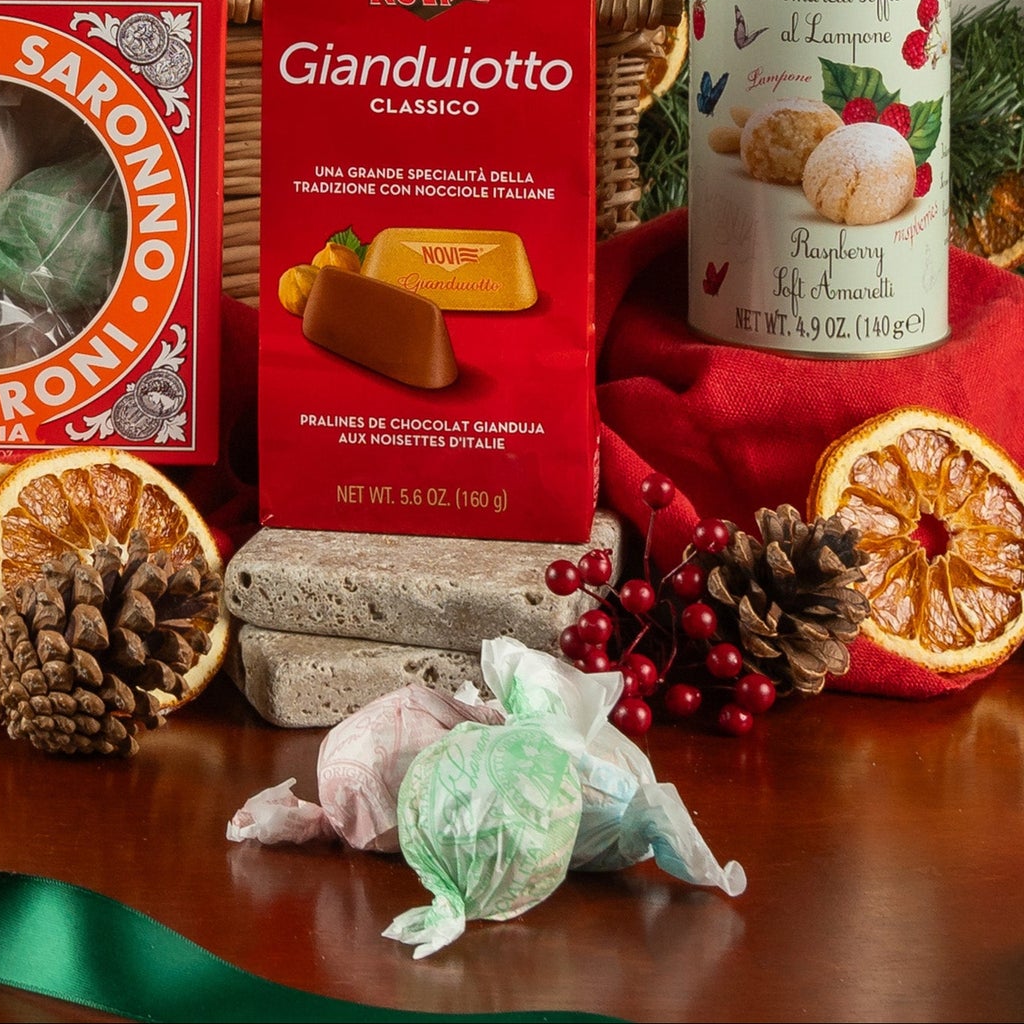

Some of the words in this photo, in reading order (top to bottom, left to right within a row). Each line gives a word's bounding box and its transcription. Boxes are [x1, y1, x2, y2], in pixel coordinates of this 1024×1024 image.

[781, 11, 800, 43] al
[805, 12, 891, 64] Lampone
[278, 41, 574, 91] Gianduiotto
[369, 98, 480, 116] CLASSICO
[14, 35, 179, 282] SARONNO
[315, 166, 344, 178] UNA
[348, 167, 404, 180] GRANDE
[407, 168, 487, 183] SPECIALITÀ
[490, 171, 534, 184] DELLA
[293, 181, 376, 194] TRADIZIONE
[380, 184, 411, 196] CON
[414, 184, 489, 198] NOCCIOLE
[492, 187, 556, 200] ITALIANE
[422, 246, 460, 265] NOVI
[790, 227, 884, 278] Raspberry
[773, 266, 806, 317] Soft
[810, 270, 895, 300] Amaretti
[736, 307, 761, 331] NET
[765, 309, 791, 337] WT.
[796, 315, 821, 341] 4.9
[826, 316, 850, 339] OZ.
[300, 414, 365, 428] PRALINES
[368, 417, 386, 429] DE
[390, 418, 470, 432] CHOCOLAT
[473, 421, 545, 435] GIANDUJA
[338, 432, 367, 445] AUX
[370, 434, 446, 448] NOISETTES
[450, 436, 506, 450] D'ITALIE
[336, 484, 365, 504] NET
[369, 486, 396, 505] WT.
[400, 487, 422, 506] 5.6
[426, 488, 451, 507] OZ.
[456, 488, 490, 510] (160
[494, 490, 508, 512] g)
